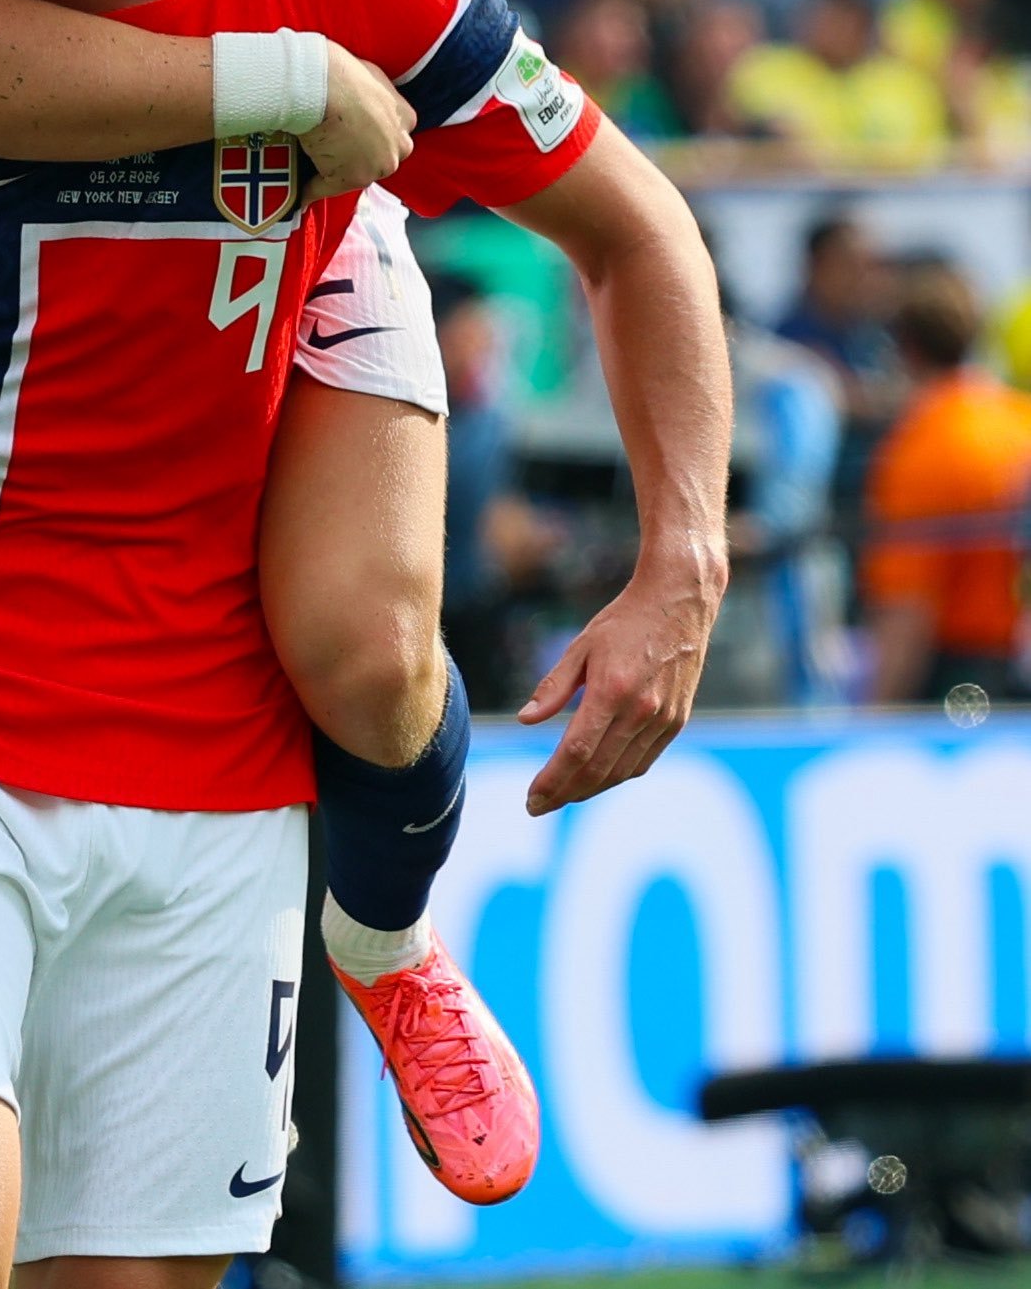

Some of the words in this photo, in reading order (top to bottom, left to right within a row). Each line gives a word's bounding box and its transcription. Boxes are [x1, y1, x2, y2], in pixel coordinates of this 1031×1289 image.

[89, 171, 161, 184] 05.07.2026
[57, 191, 81, 204] NEW
[85, 191, 115, 204] YORK
[117, 191, 143, 204] NEW
[208, 240, 287, 374] 9
